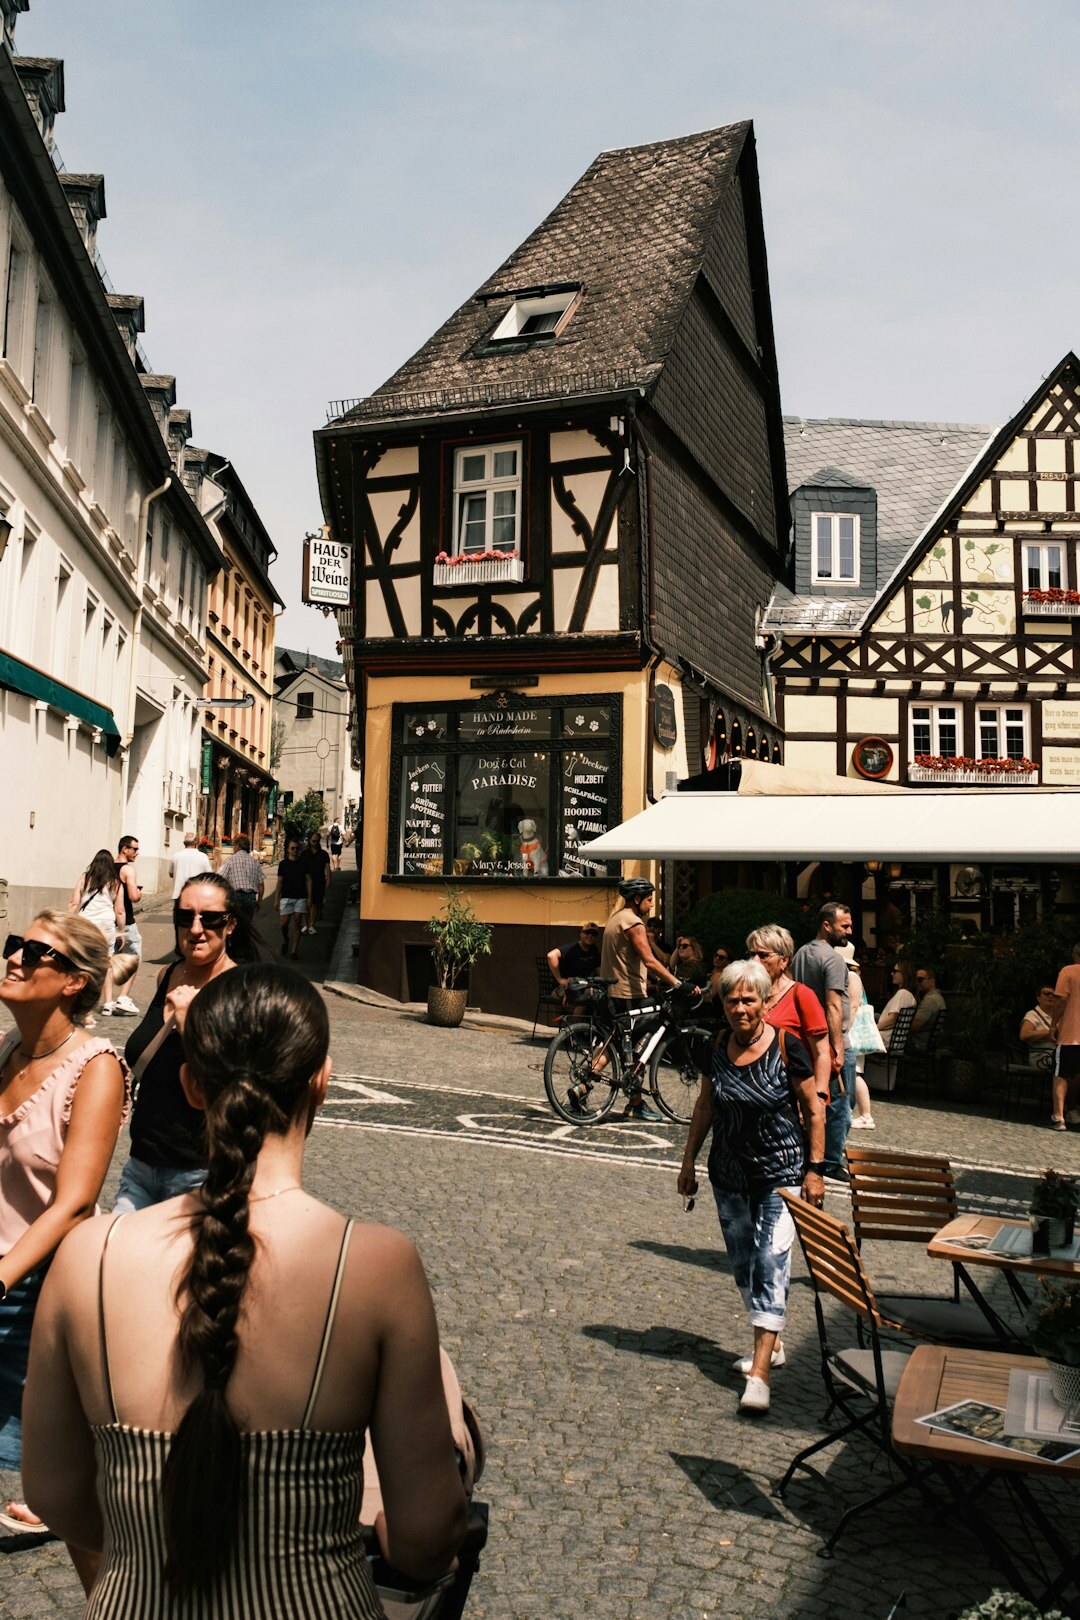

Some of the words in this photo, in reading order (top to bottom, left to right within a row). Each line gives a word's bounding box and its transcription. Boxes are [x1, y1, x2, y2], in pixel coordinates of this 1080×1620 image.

[314, 542, 348, 558] HAUS
[320, 558, 342, 568] DER
[312, 566, 349, 586] Weine
[312, 589, 348, 600] SPIRITUOSEN
[473, 712, 504, 722] HAND
[506, 711, 538, 721] MADE
[479, 758, 500, 772] Dog
[502, 759, 508, 768] &
[509, 758, 527, 768] Cat
[582, 756, 609, 773] Decken
[408, 763, 430, 780] Jacken
[472, 774, 537, 790] PARADISE
[574, 775, 605, 784] HOLZBETT
[422, 784, 442, 793] FUTTER
[415, 797, 438, 810] GRÜNE
[410, 803, 445, 820] APOTHEKE
[564, 808, 602, 816] HOODIES
[406, 819, 431, 828] NÄPFE
[577, 820, 607, 834] PYJAMAS
[415, 838, 442, 848] T-SHIRTS
[472, 860, 496, 871] Mary
[497, 861, 504, 869] &
[504, 860, 532, 871] Jessie
